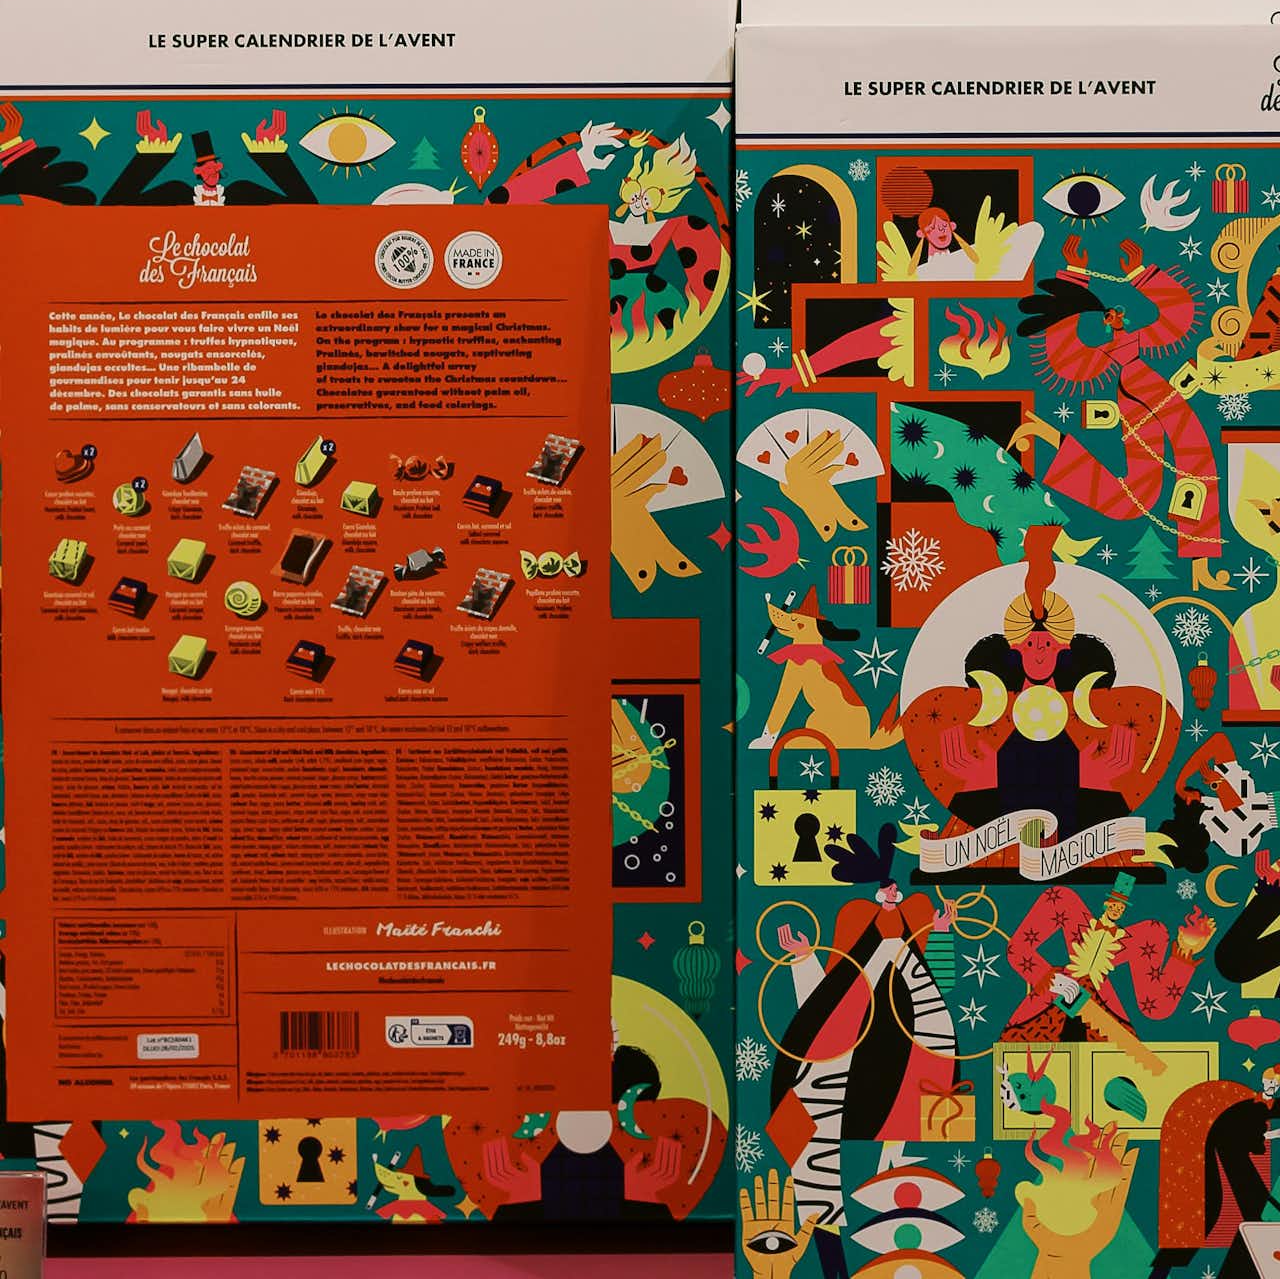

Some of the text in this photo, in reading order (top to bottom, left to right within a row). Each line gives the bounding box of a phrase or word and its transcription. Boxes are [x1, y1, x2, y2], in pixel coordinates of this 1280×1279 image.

[150, 34, 455, 48] LE SUPER CALENDRIER DE L'AVENT
[845, 81, 1156, 95] LE SUPER CALENDRIER DE L'AVENT
[149, 230, 250, 263] Le chocolat
[453, 248, 495, 257] MADE IN
[393, 247, 418, 272] 100%
[453, 258, 495, 268] FRANCE
[139, 257, 258, 290] des Français
[49, 310, 298, 321] Cette année, Le chocolat des Français enfile ses
[49, 324, 82, 333] habits
[84, 324, 98, 333] de
[100, 324, 141, 333] lumière
[143, 326, 169, 334] pour
[198, 324, 224, 333] faire
[227, 324, 255, 333] vivre
[273, 323, 299, 332] Noël
[49, 336, 297, 348] magique. Au programme truffes hypnotiques,
[944, 837, 971, 867] UN
[976, 817, 1017, 858] NOËL
[376, 922, 428, 937] Maïté
[431, 920, 502, 937] Franchi
[326, 961, 497, 971] LECHOCOLATDESFRANCAIS.FR
[498, 1033, 566, 1049] 249g 8,8oz
